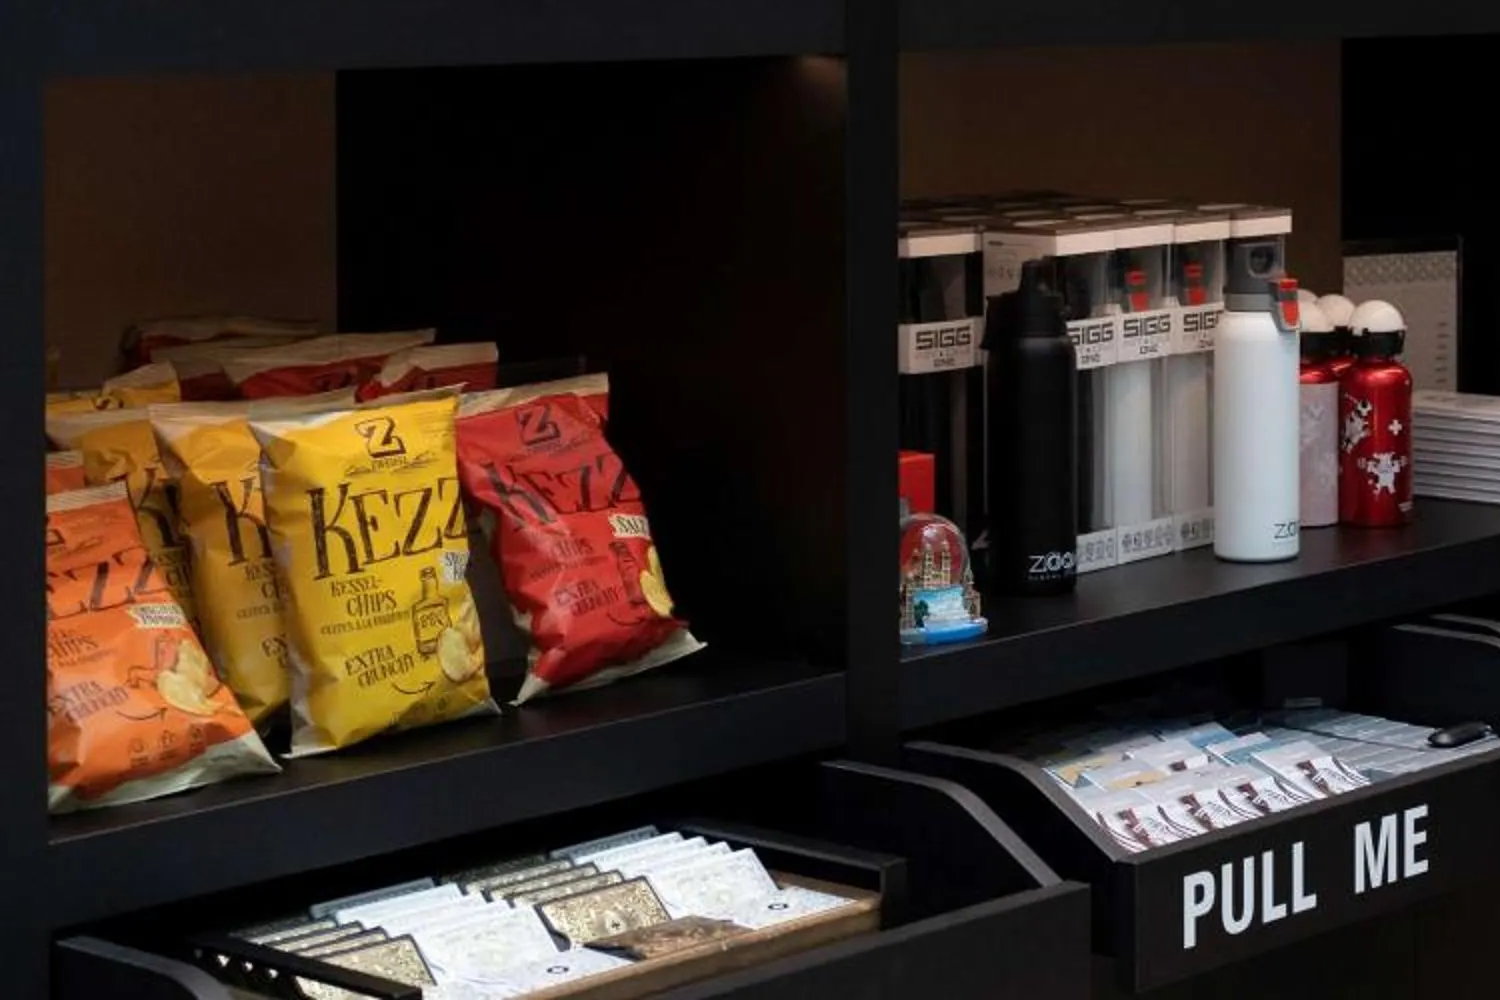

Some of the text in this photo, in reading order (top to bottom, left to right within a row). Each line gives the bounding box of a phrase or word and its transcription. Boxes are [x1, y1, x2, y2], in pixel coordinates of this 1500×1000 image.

[916, 327, 971, 350] SIGG
[1067, 322, 1114, 347] SIGG
[1123, 314, 1171, 338] SIGG
[347, 589, 397, 617] CHIPS
[1183, 803, 1430, 949] PULL ME
